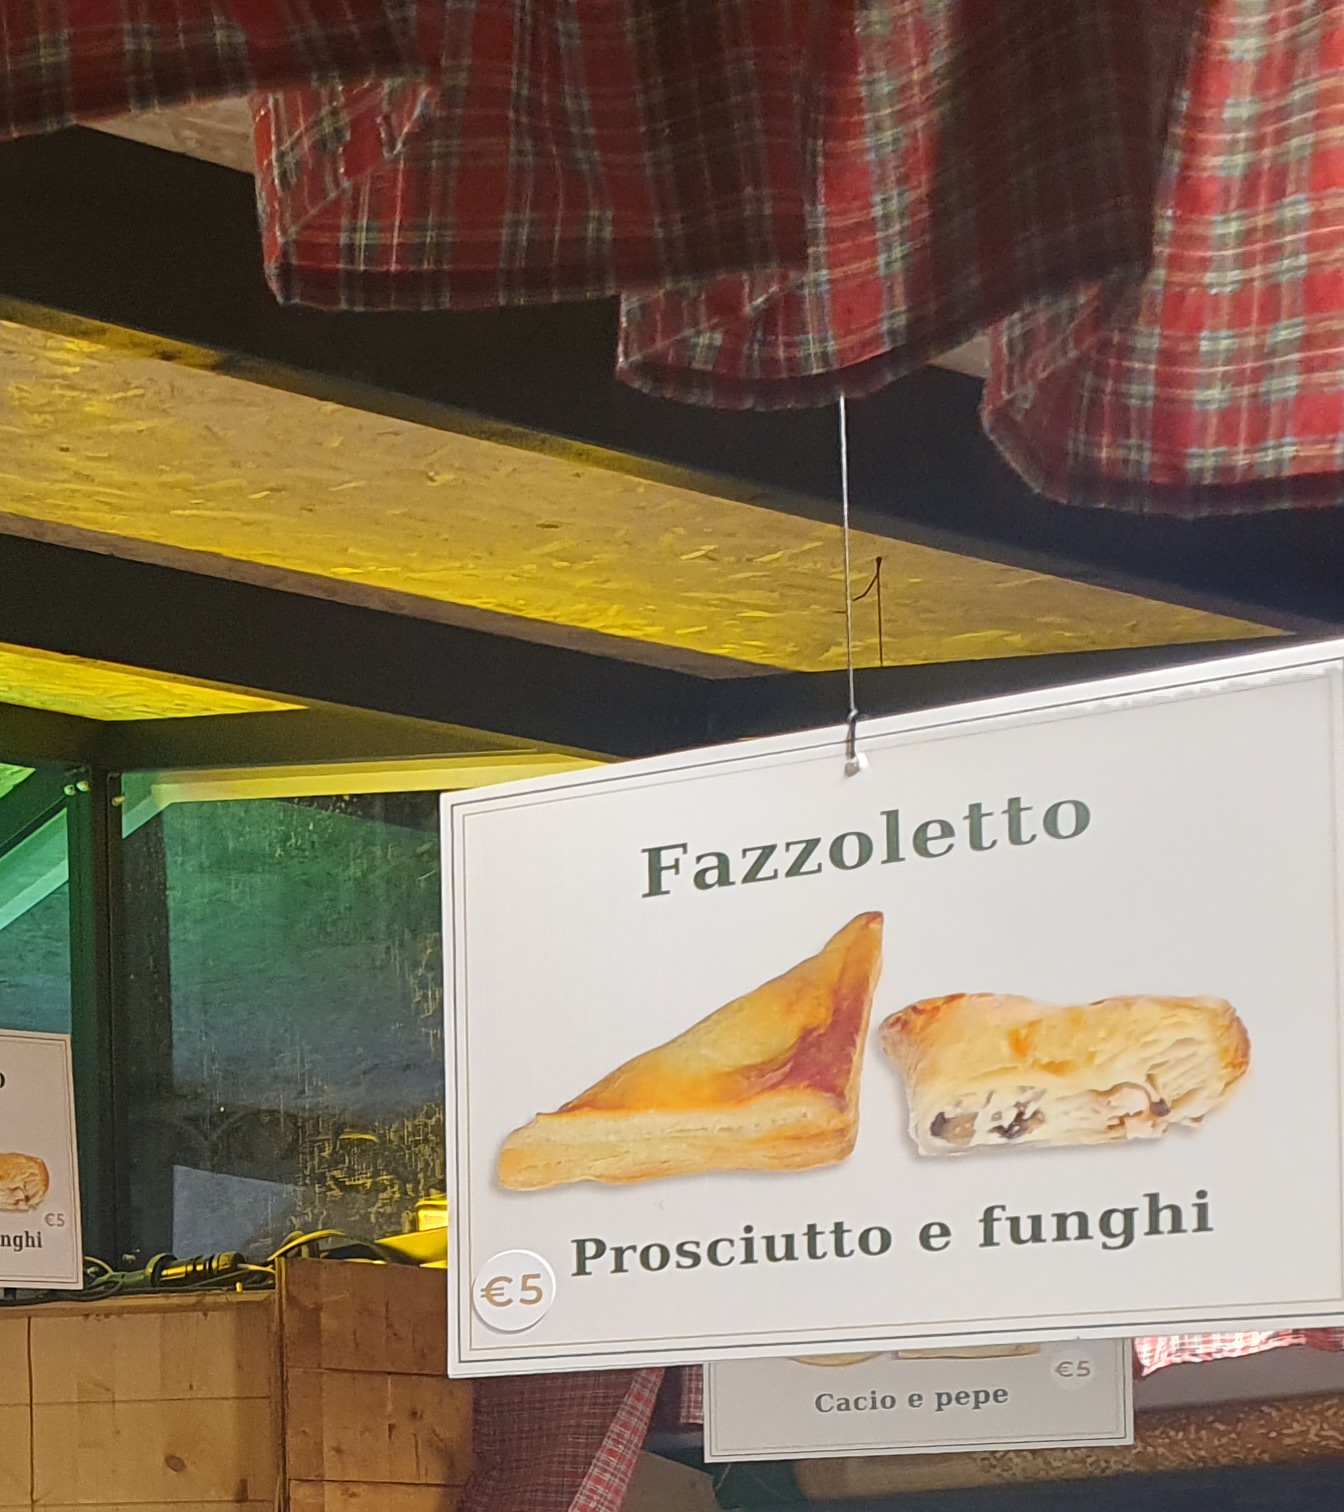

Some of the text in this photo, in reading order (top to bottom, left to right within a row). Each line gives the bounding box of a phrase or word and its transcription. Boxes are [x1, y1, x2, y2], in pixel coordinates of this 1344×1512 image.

[641, 796, 1092, 899] Fazzoletto
[44, 1212, 66, 1227] €5
[570, 1189, 1215, 1277] Prosciutto e funghi
[480, 1272, 544, 1308] €5
[1054, 1360, 1092, 1378] €5
[814, 1387, 1010, 1413] Cacio e pepe
